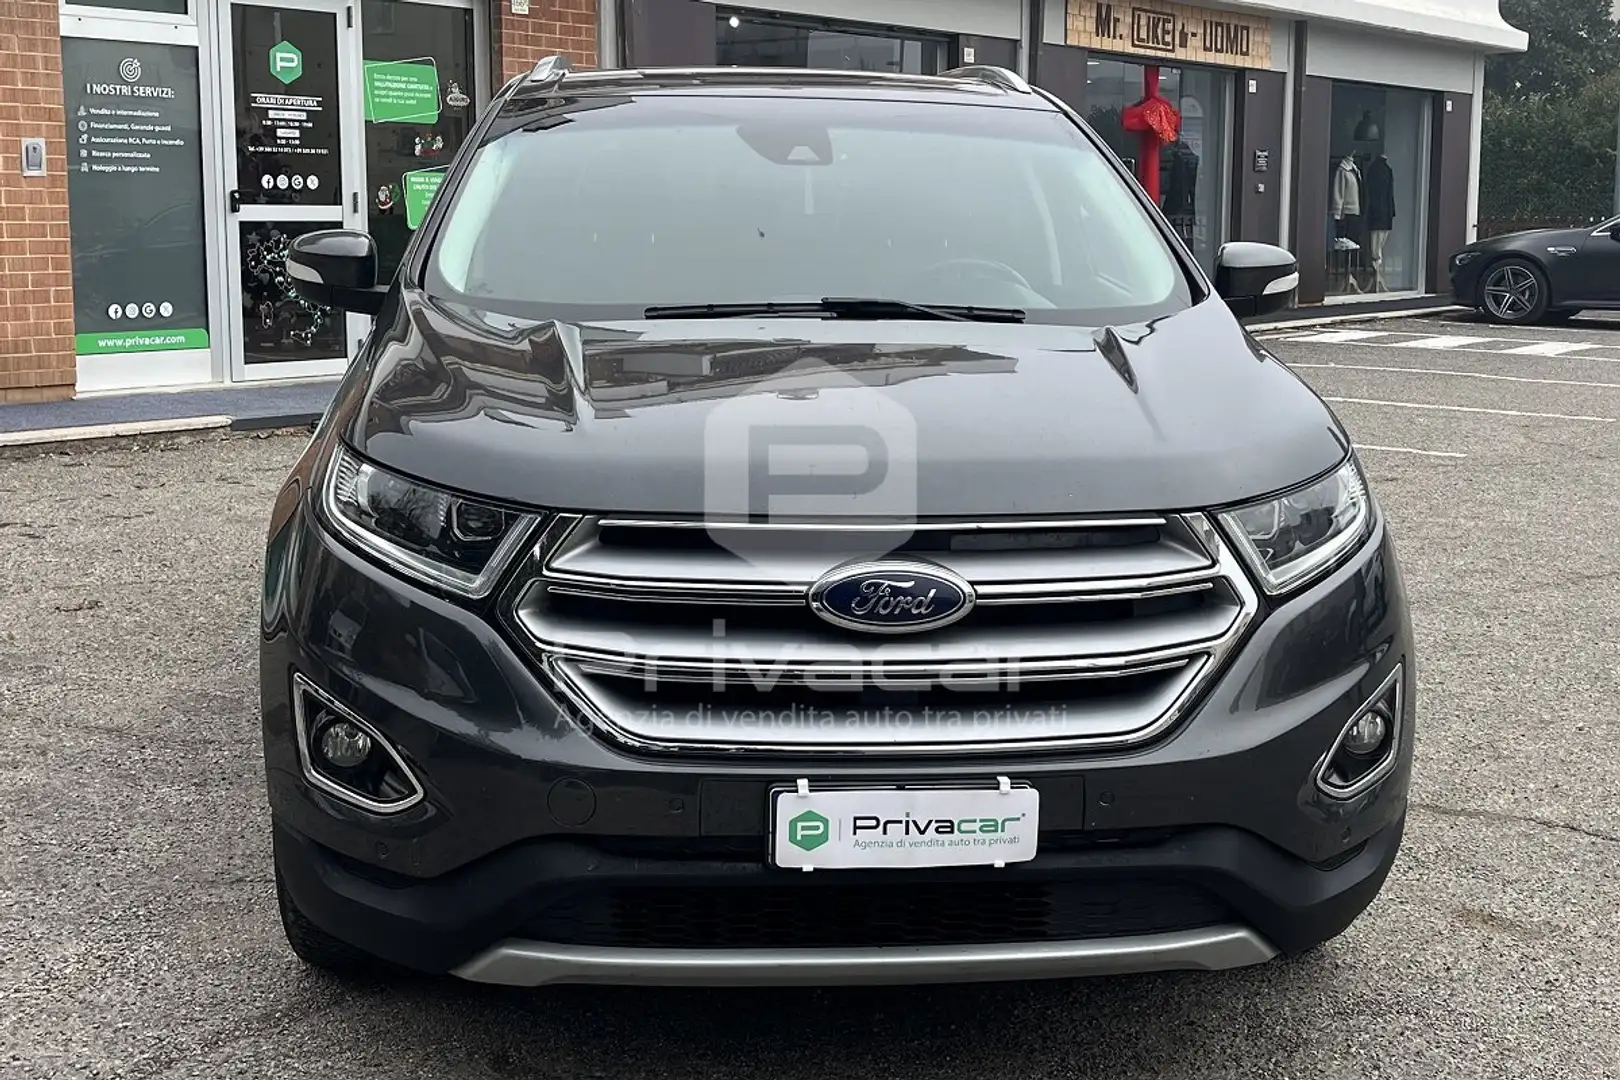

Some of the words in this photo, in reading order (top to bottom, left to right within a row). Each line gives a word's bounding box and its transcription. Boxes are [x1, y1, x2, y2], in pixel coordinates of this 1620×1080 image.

[1096, 4, 1123, 40] Mr.
[1136, 13, 1172, 47] LIKE
[1203, 20, 1250, 56] UOMO
[275, 52, 298, 71] P
[86, 83, 91, 94] I
[92, 84, 132, 96] NOSTRI
[133, 86, 175, 99] SERVIZI:
[277, 97, 284, 105] DI
[285, 98, 318, 106] APERTURA
[98, 335, 186, 348] www.privacar.com
[851, 579, 937, 615] Ford
[797, 821, 824, 840] P
[852, 811, 1021, 836] Privacar
[853, 839, 894, 850] Agenzia
[896, 839, 906, 848] di
[908, 838, 945, 848] vendita
[947, 838, 971, 847] auto
[973, 837, 987, 846] tra
[988, 836, 1020, 848] privati
